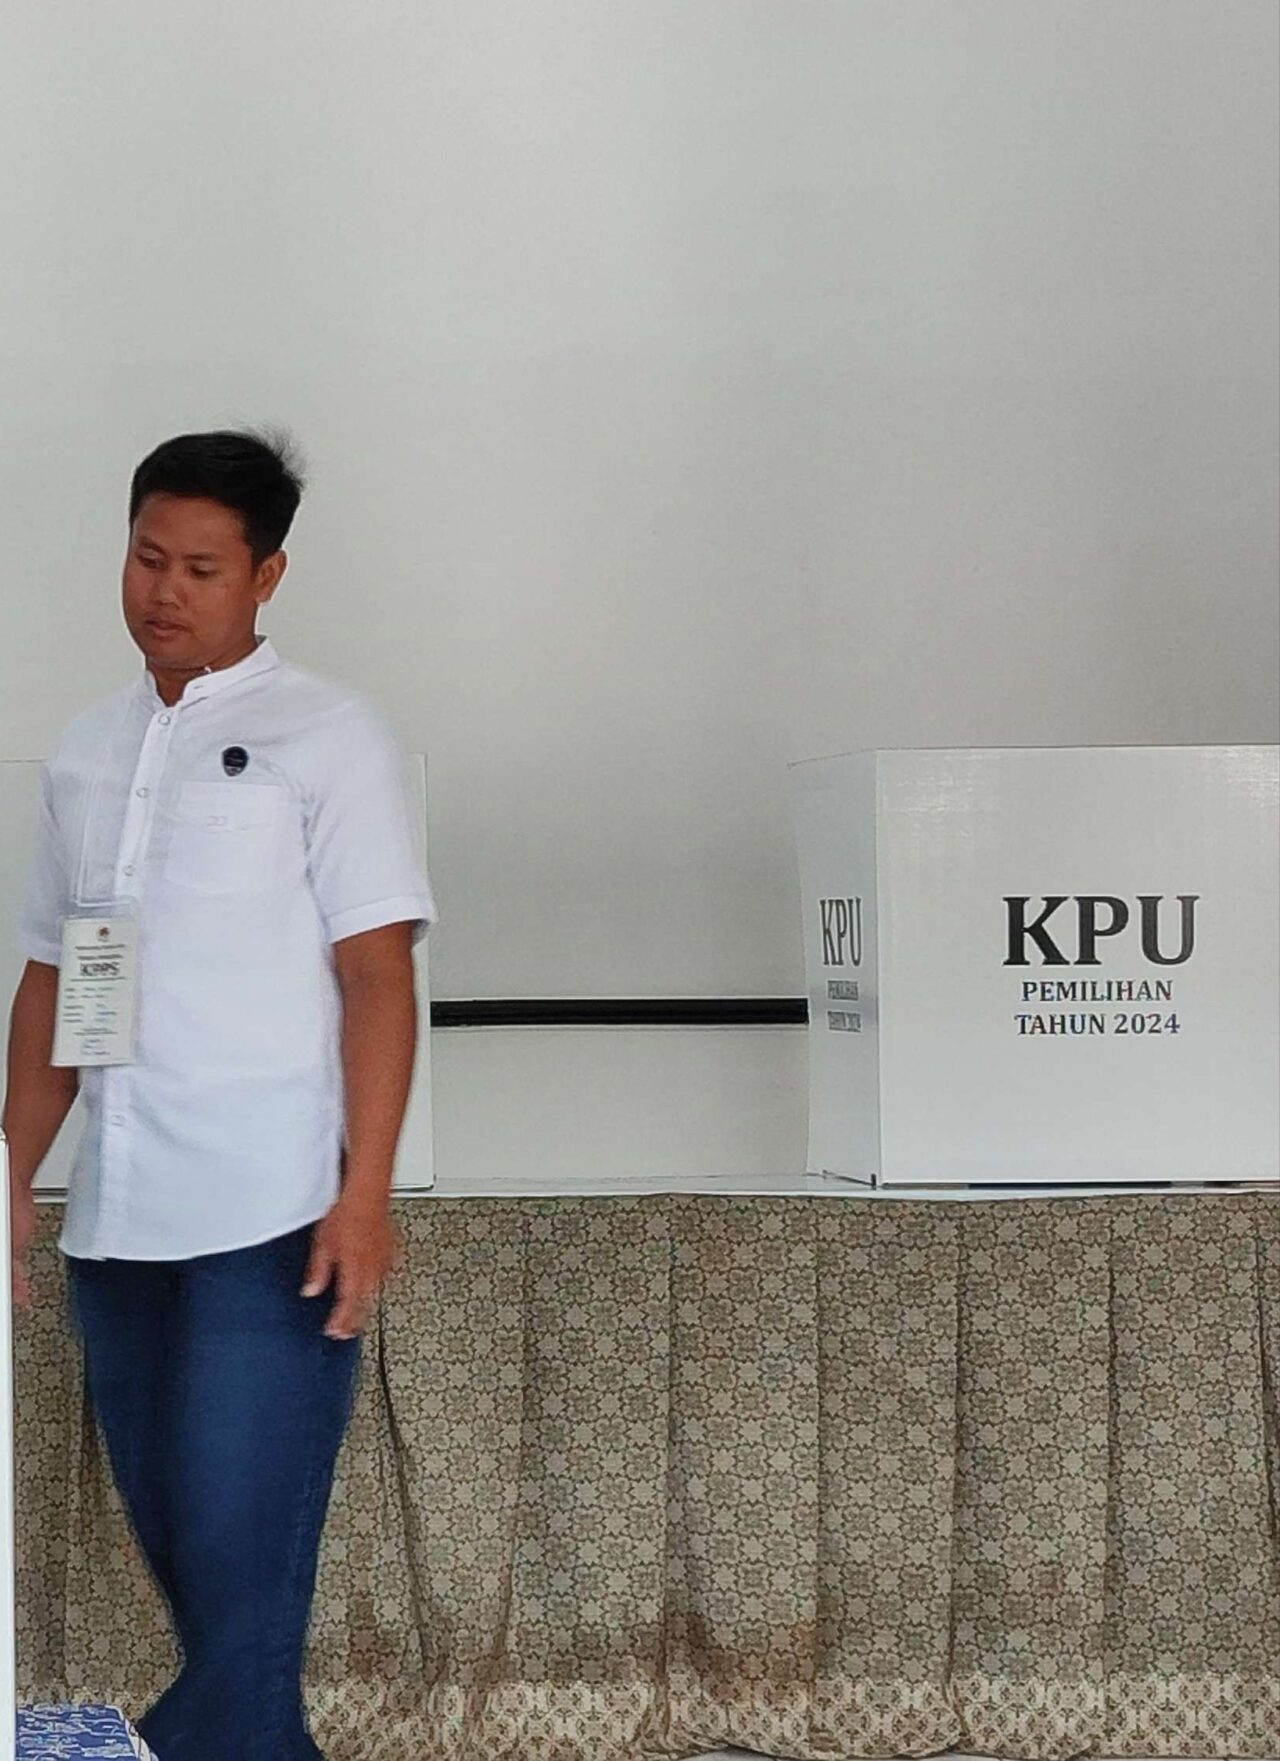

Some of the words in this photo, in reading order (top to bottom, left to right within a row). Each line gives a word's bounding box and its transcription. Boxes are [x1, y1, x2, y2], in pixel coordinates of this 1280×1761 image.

[820, 896, 862, 967] KPU
[1002, 895, 1200, 966] KPU
[1021, 979, 1173, 1002] PEMILIHAN
[1014, 1013, 1105, 1036] TAHUN
[1113, 1013, 1181, 1035] 2024
